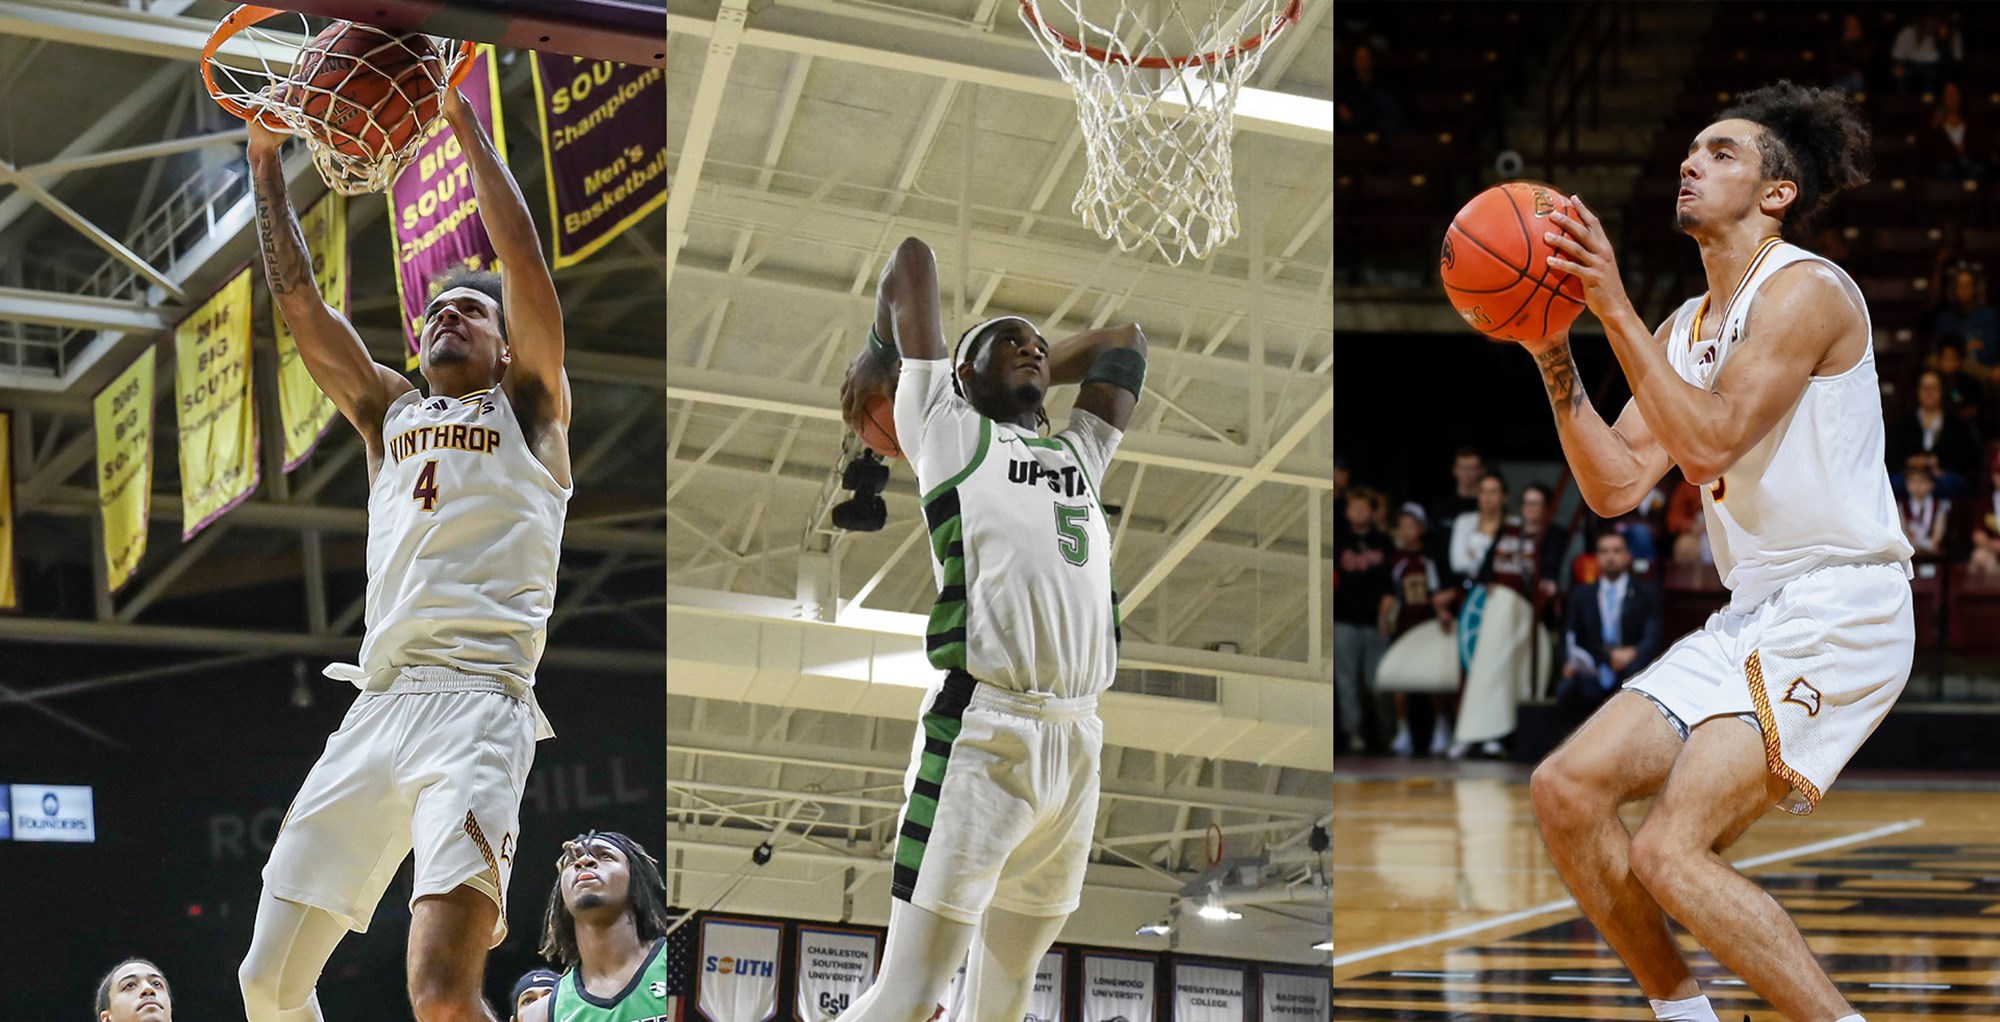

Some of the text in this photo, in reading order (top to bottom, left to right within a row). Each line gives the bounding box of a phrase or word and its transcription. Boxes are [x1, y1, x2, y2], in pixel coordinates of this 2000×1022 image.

[552, 60, 626, 115] SOU
[418, 133, 462, 183] BIG
[583, 144, 644, 196] Men's
[402, 161, 470, 231] SOUT
[564, 147, 667, 235] Basketball
[400, 197, 479, 264] Champio
[413, 459, 440, 512] 4
[1008, 459, 1090, 498] UPSTA
[1054, 501, 1089, 567] 5
[807, 946, 869, 960] CHARLESTON
[811, 958, 863, 972] SOUTHERN
[808, 971, 865, 984] UNIVERSITY
[1093, 977, 1145, 990] LONGWOOD
[1177, 984, 1243, 998] PRESBYTERIAN
[819, 991, 850, 1016] CSU
[1091, 988, 1145, 1001] UNIVERSITY
[1190, 997, 1228, 1009] COLLEGE
[1270, 1004, 1323, 1017] UNIVERSITY
